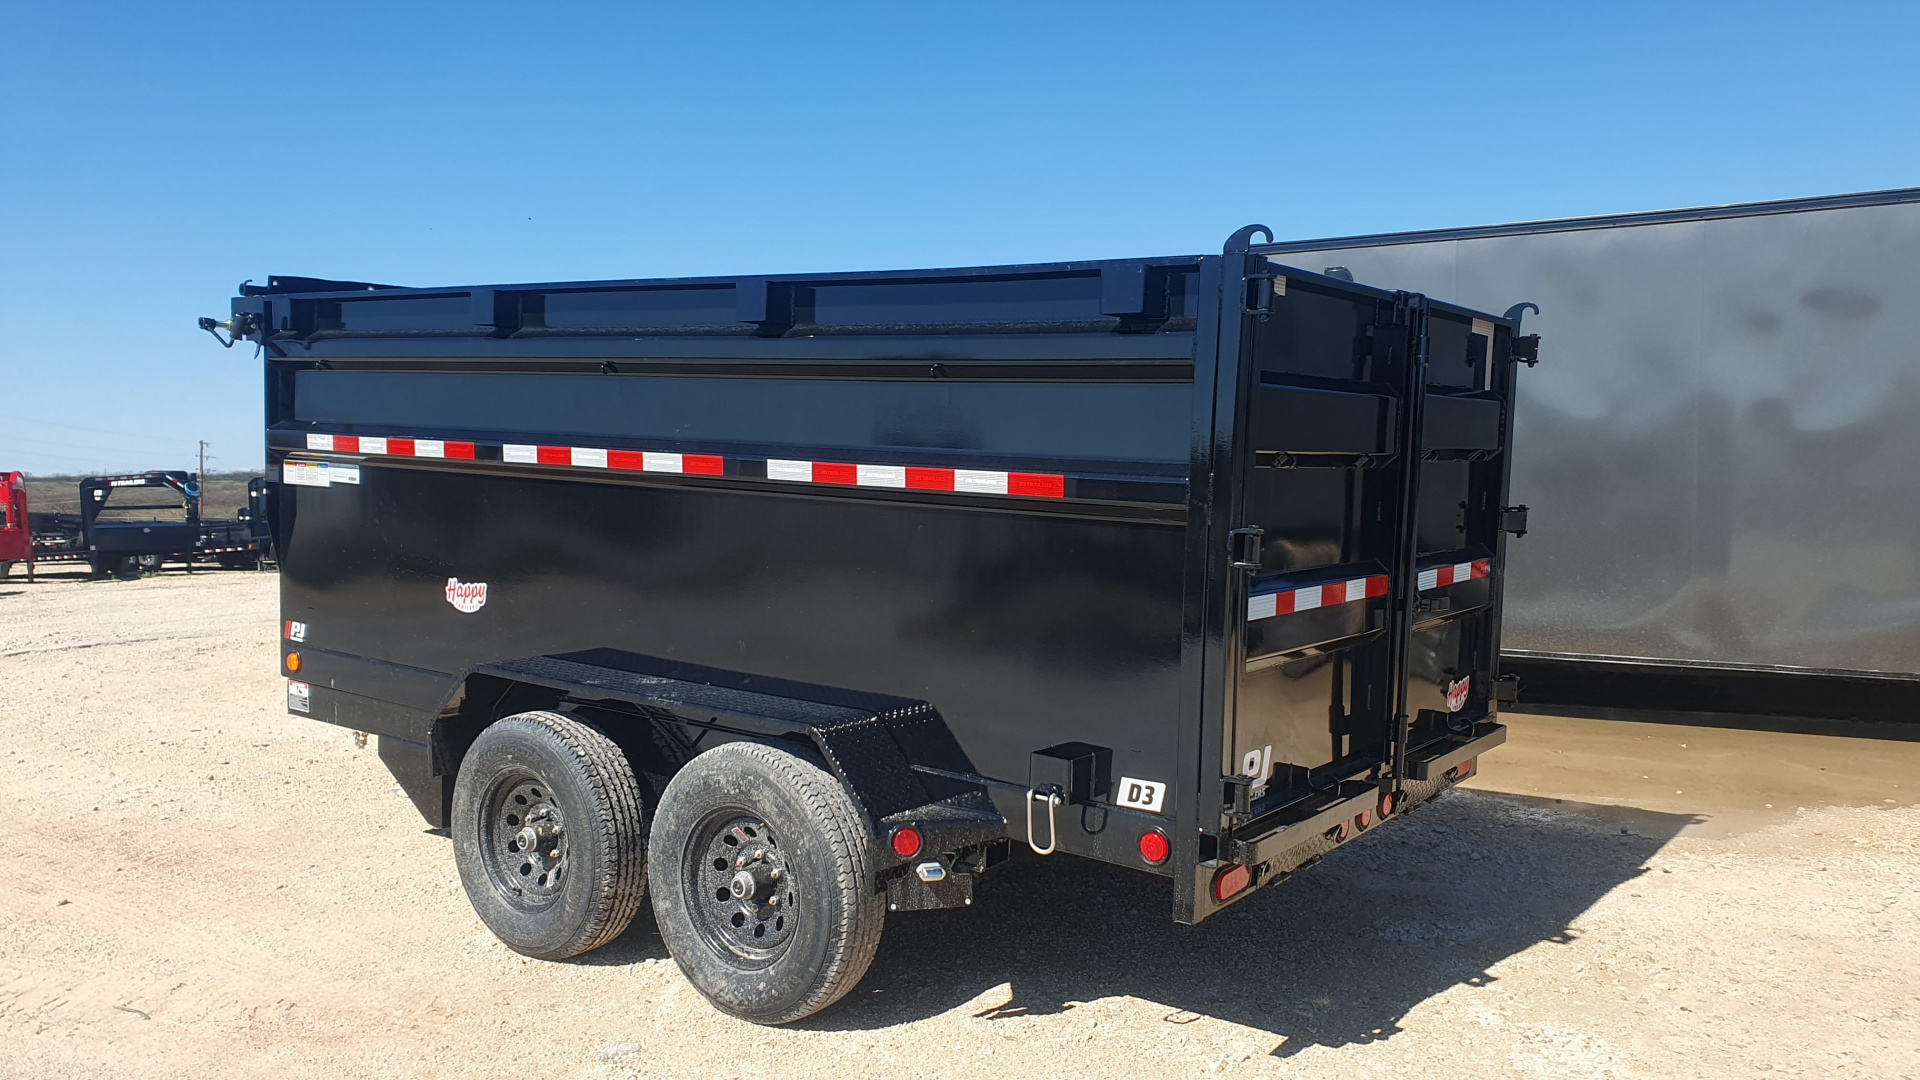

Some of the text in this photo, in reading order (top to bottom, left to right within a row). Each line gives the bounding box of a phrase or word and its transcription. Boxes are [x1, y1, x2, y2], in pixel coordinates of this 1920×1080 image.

[447, 579, 486, 604] Happy
[290, 621, 306, 638] PJ
[1448, 677, 1470, 706] Happy
[1127, 782, 1155, 805] D3
